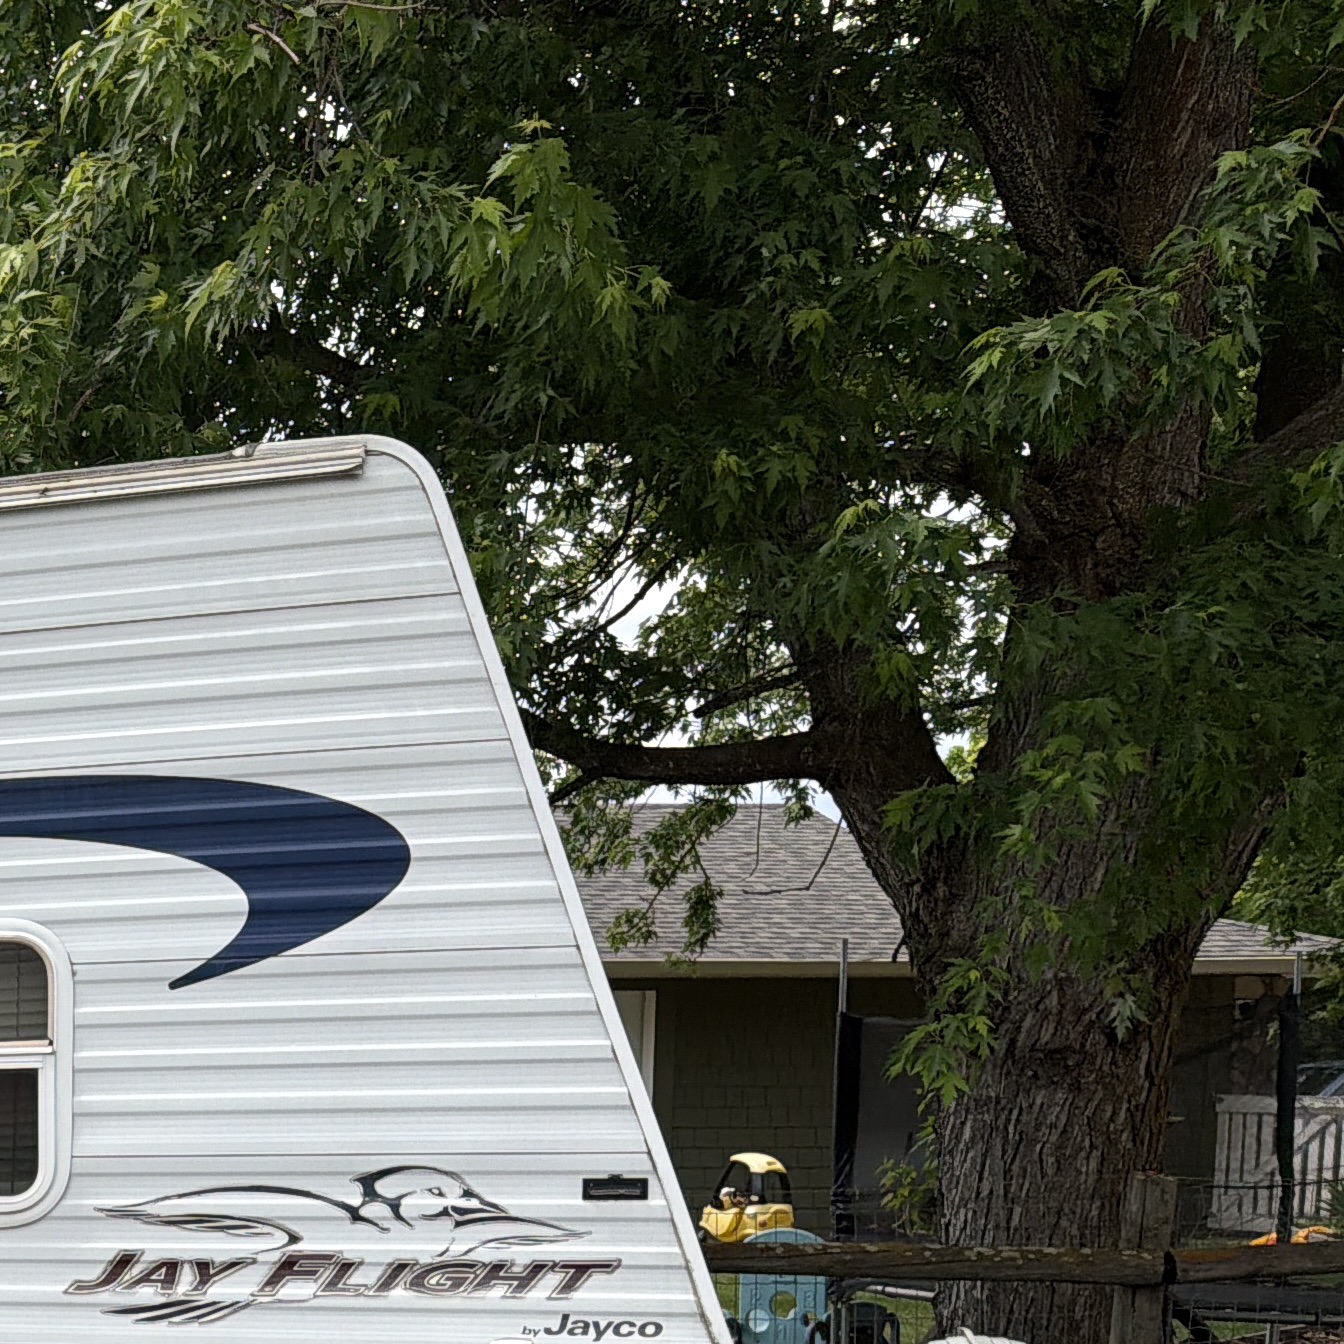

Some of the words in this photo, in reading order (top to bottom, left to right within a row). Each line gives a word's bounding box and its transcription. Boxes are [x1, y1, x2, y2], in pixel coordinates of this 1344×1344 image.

[63, 1249, 257, 1298] JAY
[249, 1250, 622, 1301] FLIGHT
[521, 1325, 541, 1338] by
[543, 1313, 664, 1342] Jayco
